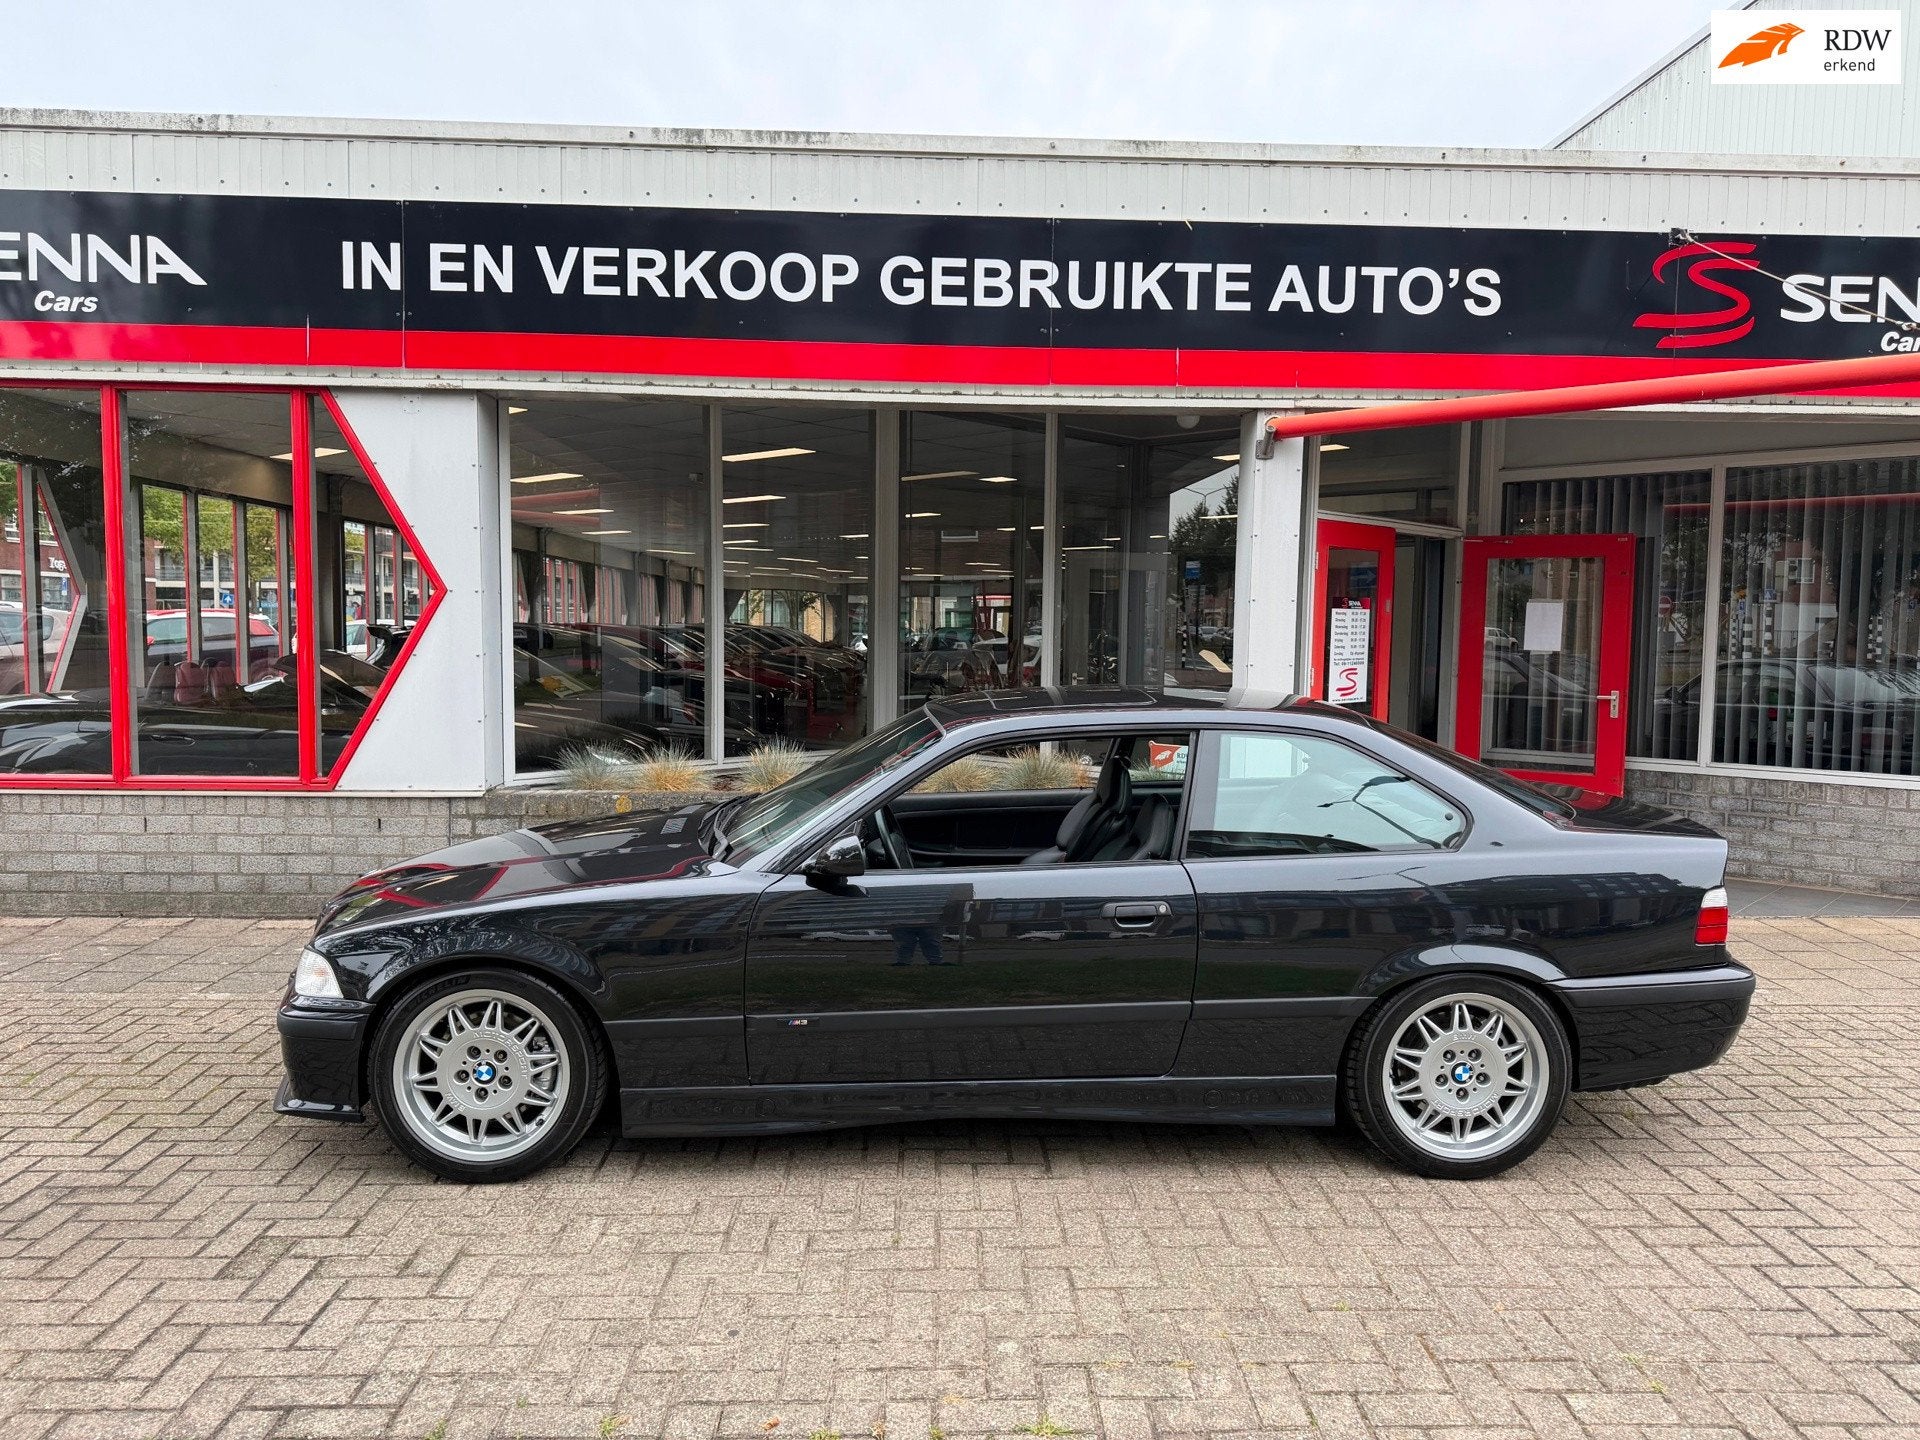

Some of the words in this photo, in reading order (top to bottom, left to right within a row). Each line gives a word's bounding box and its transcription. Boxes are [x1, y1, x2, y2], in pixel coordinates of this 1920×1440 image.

[34, 290, 98, 312] Cars
[342, 241, 401, 291] IN
[429, 243, 513, 293] EN
[535, 246, 860, 302] VERKOOP
[879, 255, 1252, 312] GEBRUIKTE
[1268, 265, 1502, 317] AUTO'S
